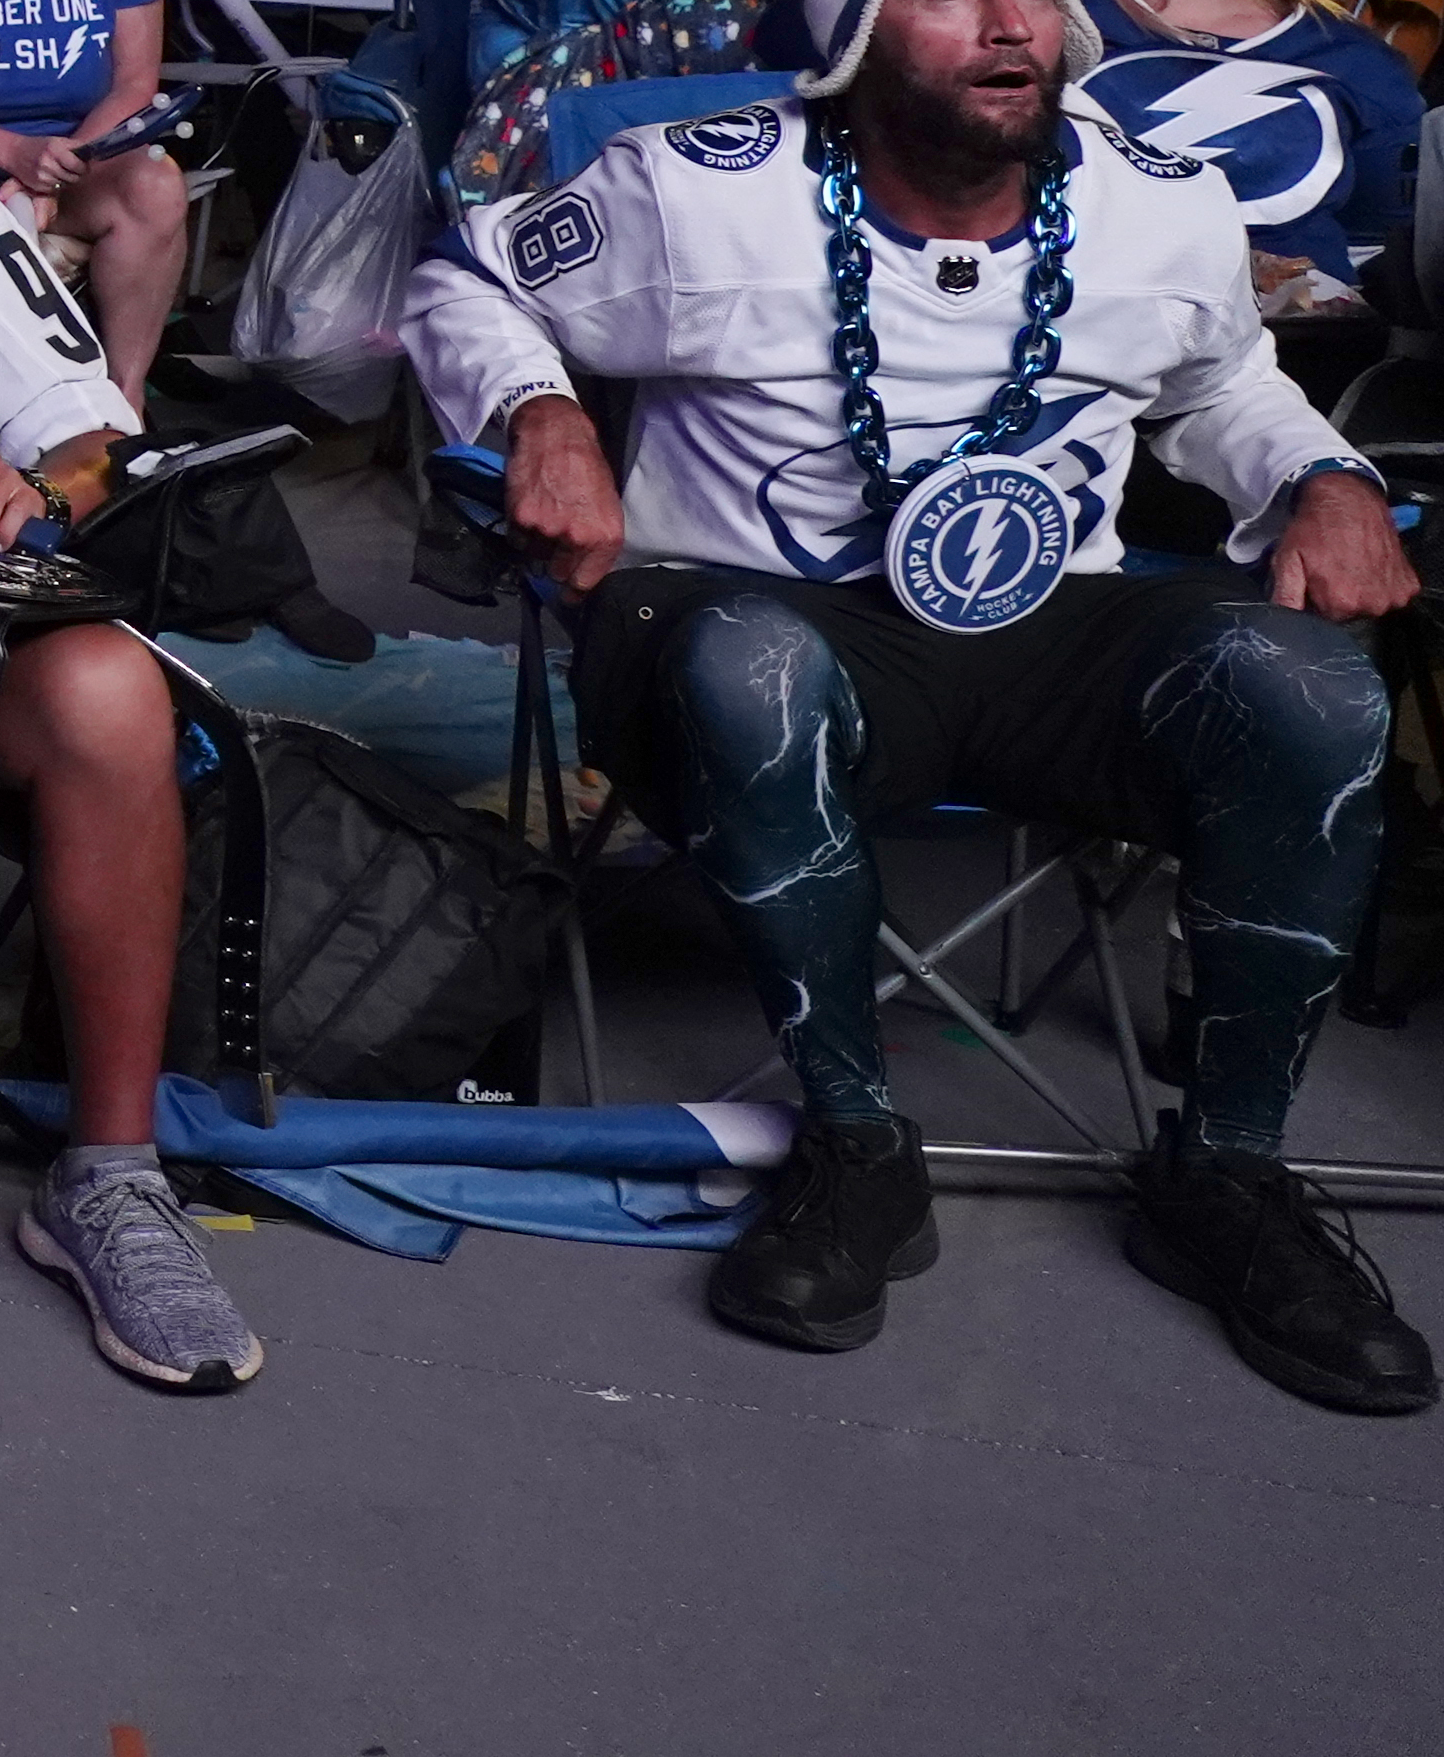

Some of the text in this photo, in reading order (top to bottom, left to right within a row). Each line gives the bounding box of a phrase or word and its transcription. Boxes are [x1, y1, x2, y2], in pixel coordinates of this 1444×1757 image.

[704, 118, 777, 169] LIGHTNING
[1129, 154, 1187, 177] TAMPA
[506, 191, 602, 292] 8
[502, 380, 558, 408] TAMPA
[908, 476, 1062, 613] TAMPA BAY LIGHTNING
[976, 587, 1024, 612] HOCKEY
[987, 602, 1018, 619] CLUB
[457, 1079, 516, 1104] bubba
